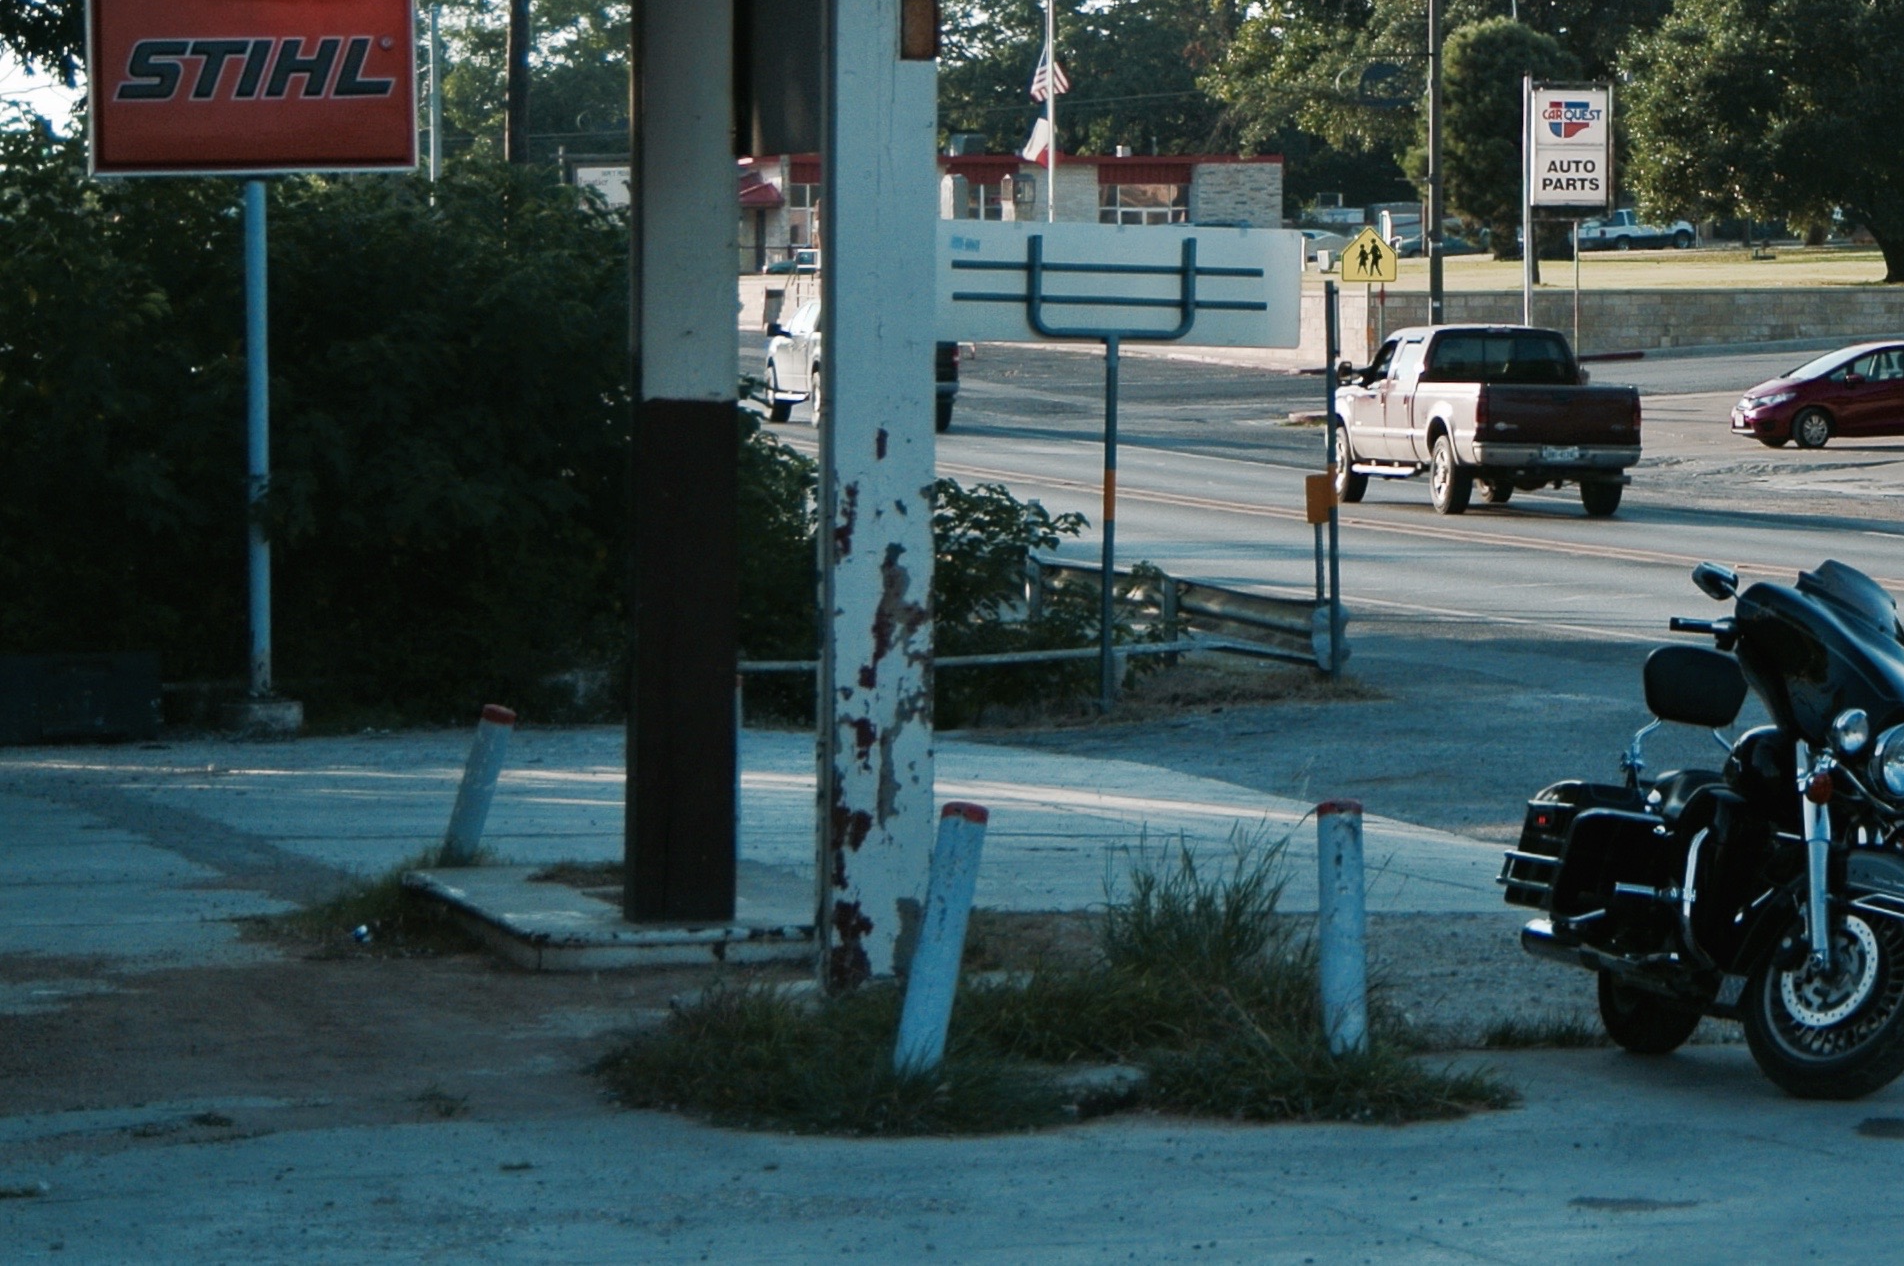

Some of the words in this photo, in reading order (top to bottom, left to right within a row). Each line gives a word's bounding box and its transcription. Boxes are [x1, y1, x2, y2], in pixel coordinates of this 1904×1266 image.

[113, 36, 396, 102] STIHL
[1542, 109, 1602, 122] CARQUEST
[1547, 160, 1596, 173] AUTO
[1542, 178, 1600, 191] PARTS
